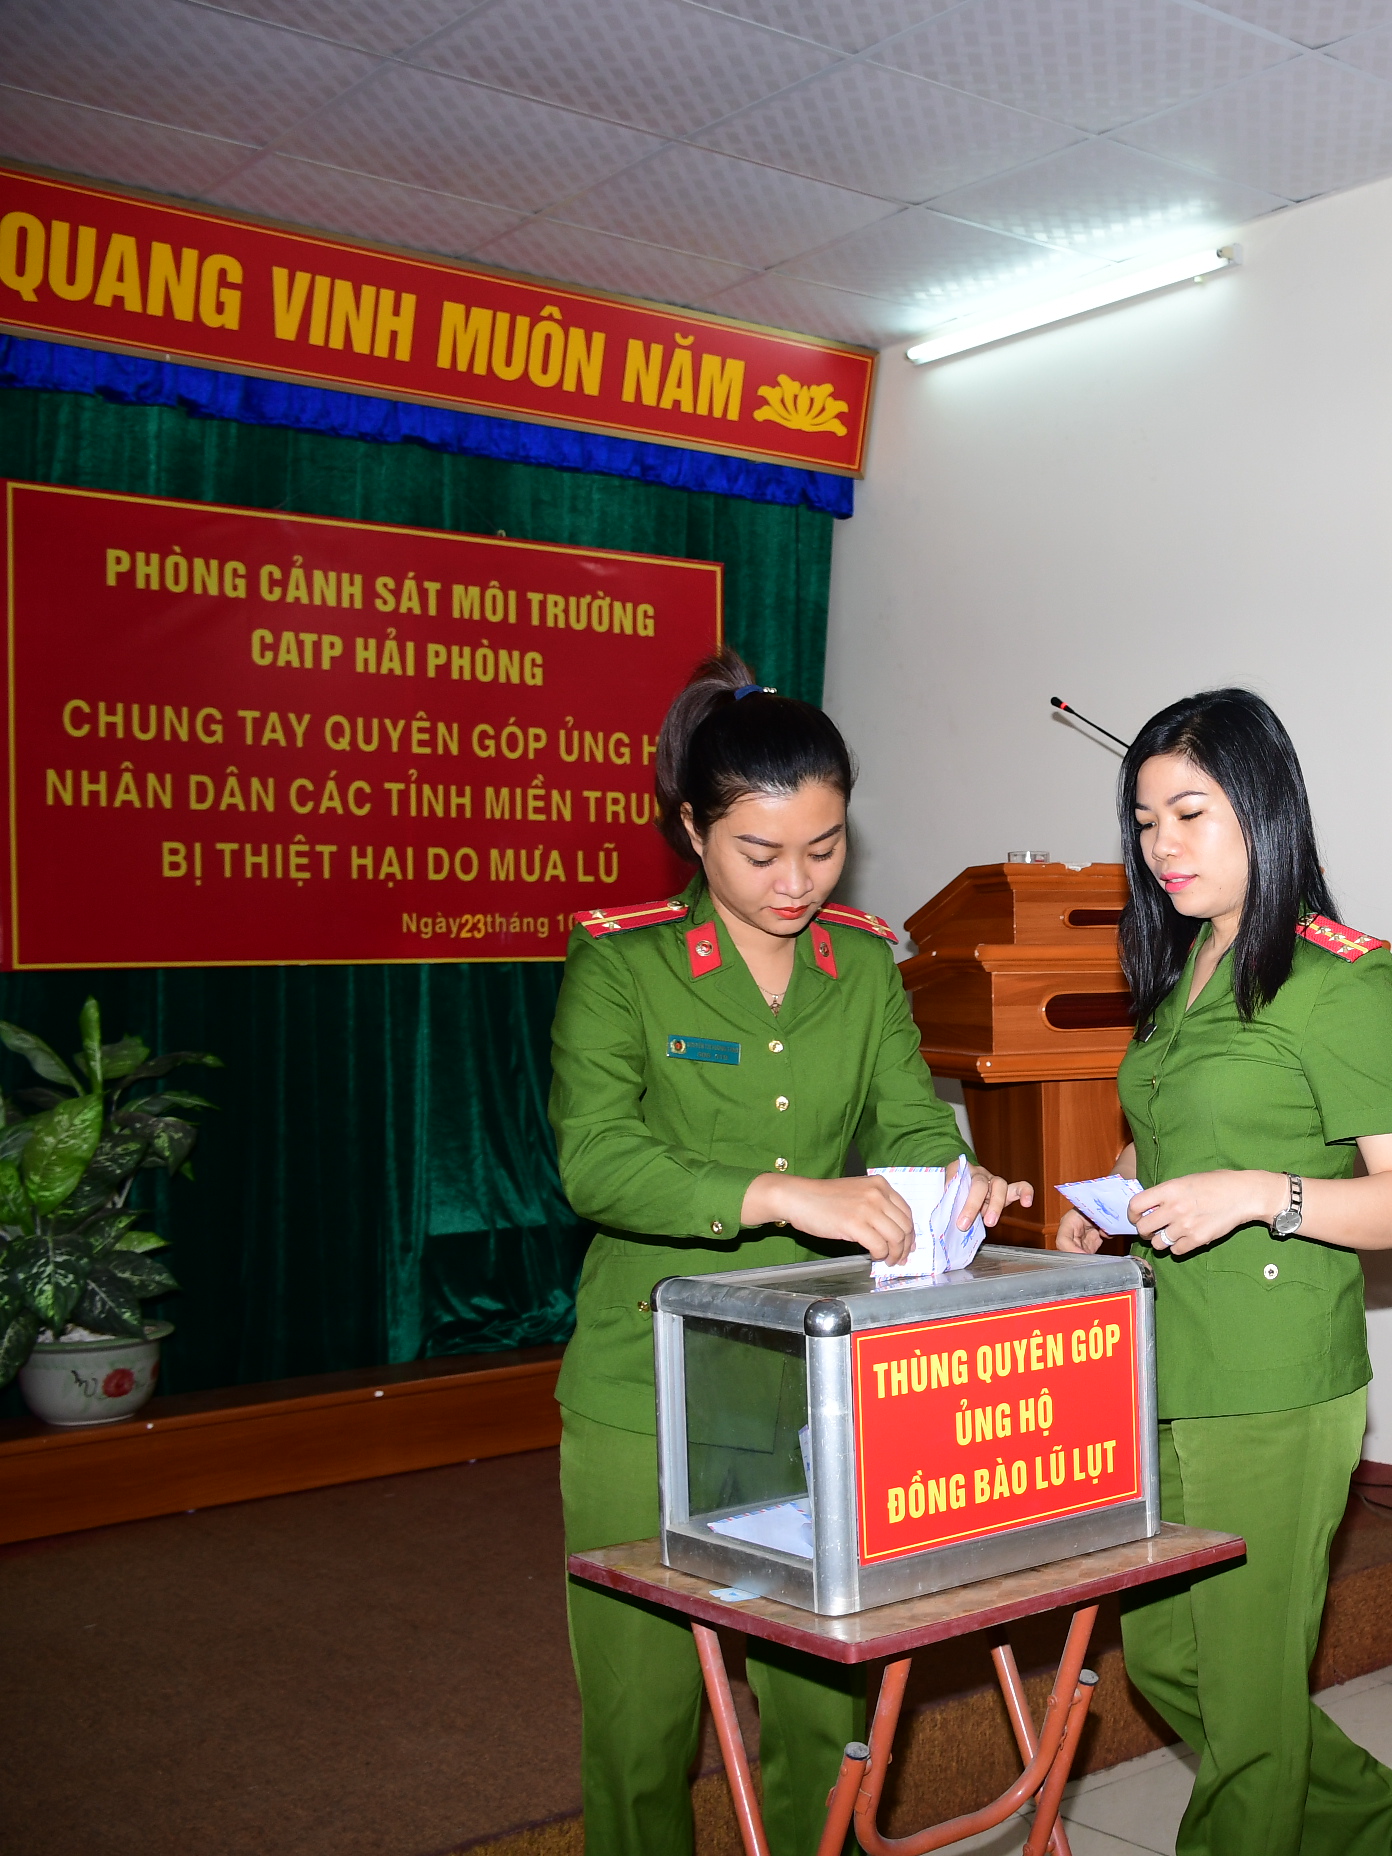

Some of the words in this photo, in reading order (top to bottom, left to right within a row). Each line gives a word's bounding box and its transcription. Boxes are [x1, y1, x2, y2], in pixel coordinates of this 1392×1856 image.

[0, 207, 242, 333] QUANG
[273, 267, 416, 361] VINH
[437, 302, 605, 396] MUÔN
[622, 333, 745, 421] NĂM
[107, 546, 246, 598] PHÒNG
[260, 555, 363, 609] CẢNH
[375, 572, 441, 616] SÁT
[452, 581, 516, 623] MÔI
[527, 591, 654, 637] TRƯỜNG
[252, 628, 343, 670] CATP
[356, 627, 415, 676] HẢI
[427, 638, 543, 686] PHÒNG
[63, 699, 223, 743] CHUNG
[238, 710, 311, 747] TAY
[325, 711, 458, 755] QUYÊN
[472, 717, 547, 759] GÓP
[560, 716, 630, 765] ỦNG
[643, 735, 657, 765] H
[47, 762, 172, 808] NHÂN
[189, 766, 275, 812] DÂN
[290, 770, 371, 816] CÁC
[384, 769, 471, 818] TỈNH
[486, 774, 571, 821] MIỀN
[583, 790, 659, 825] TRU
[163, 842, 201, 885] BỊ
[216, 835, 337, 886] THIỆT
[351, 846, 413, 887] HẠI
[428, 847, 478, 881] DO
[490, 845, 566, 882] MƯA
[578, 843, 618, 883] LŨ
[873, 1349, 968, 1398] THÙNG
[977, 1330, 1063, 1383] QUYÊN
[1072, 1319, 1120, 1363] GÓP
[956, 1399, 1012, 1445] ỦNG
[1020, 1388, 1053, 1436] HỘ
[888, 1470, 965, 1523] ĐỒNG
[974, 1458, 1027, 1504] BÀO
[1036, 1445, 1065, 1489] LŨ
[1073, 1440, 1116, 1484] LỤT
